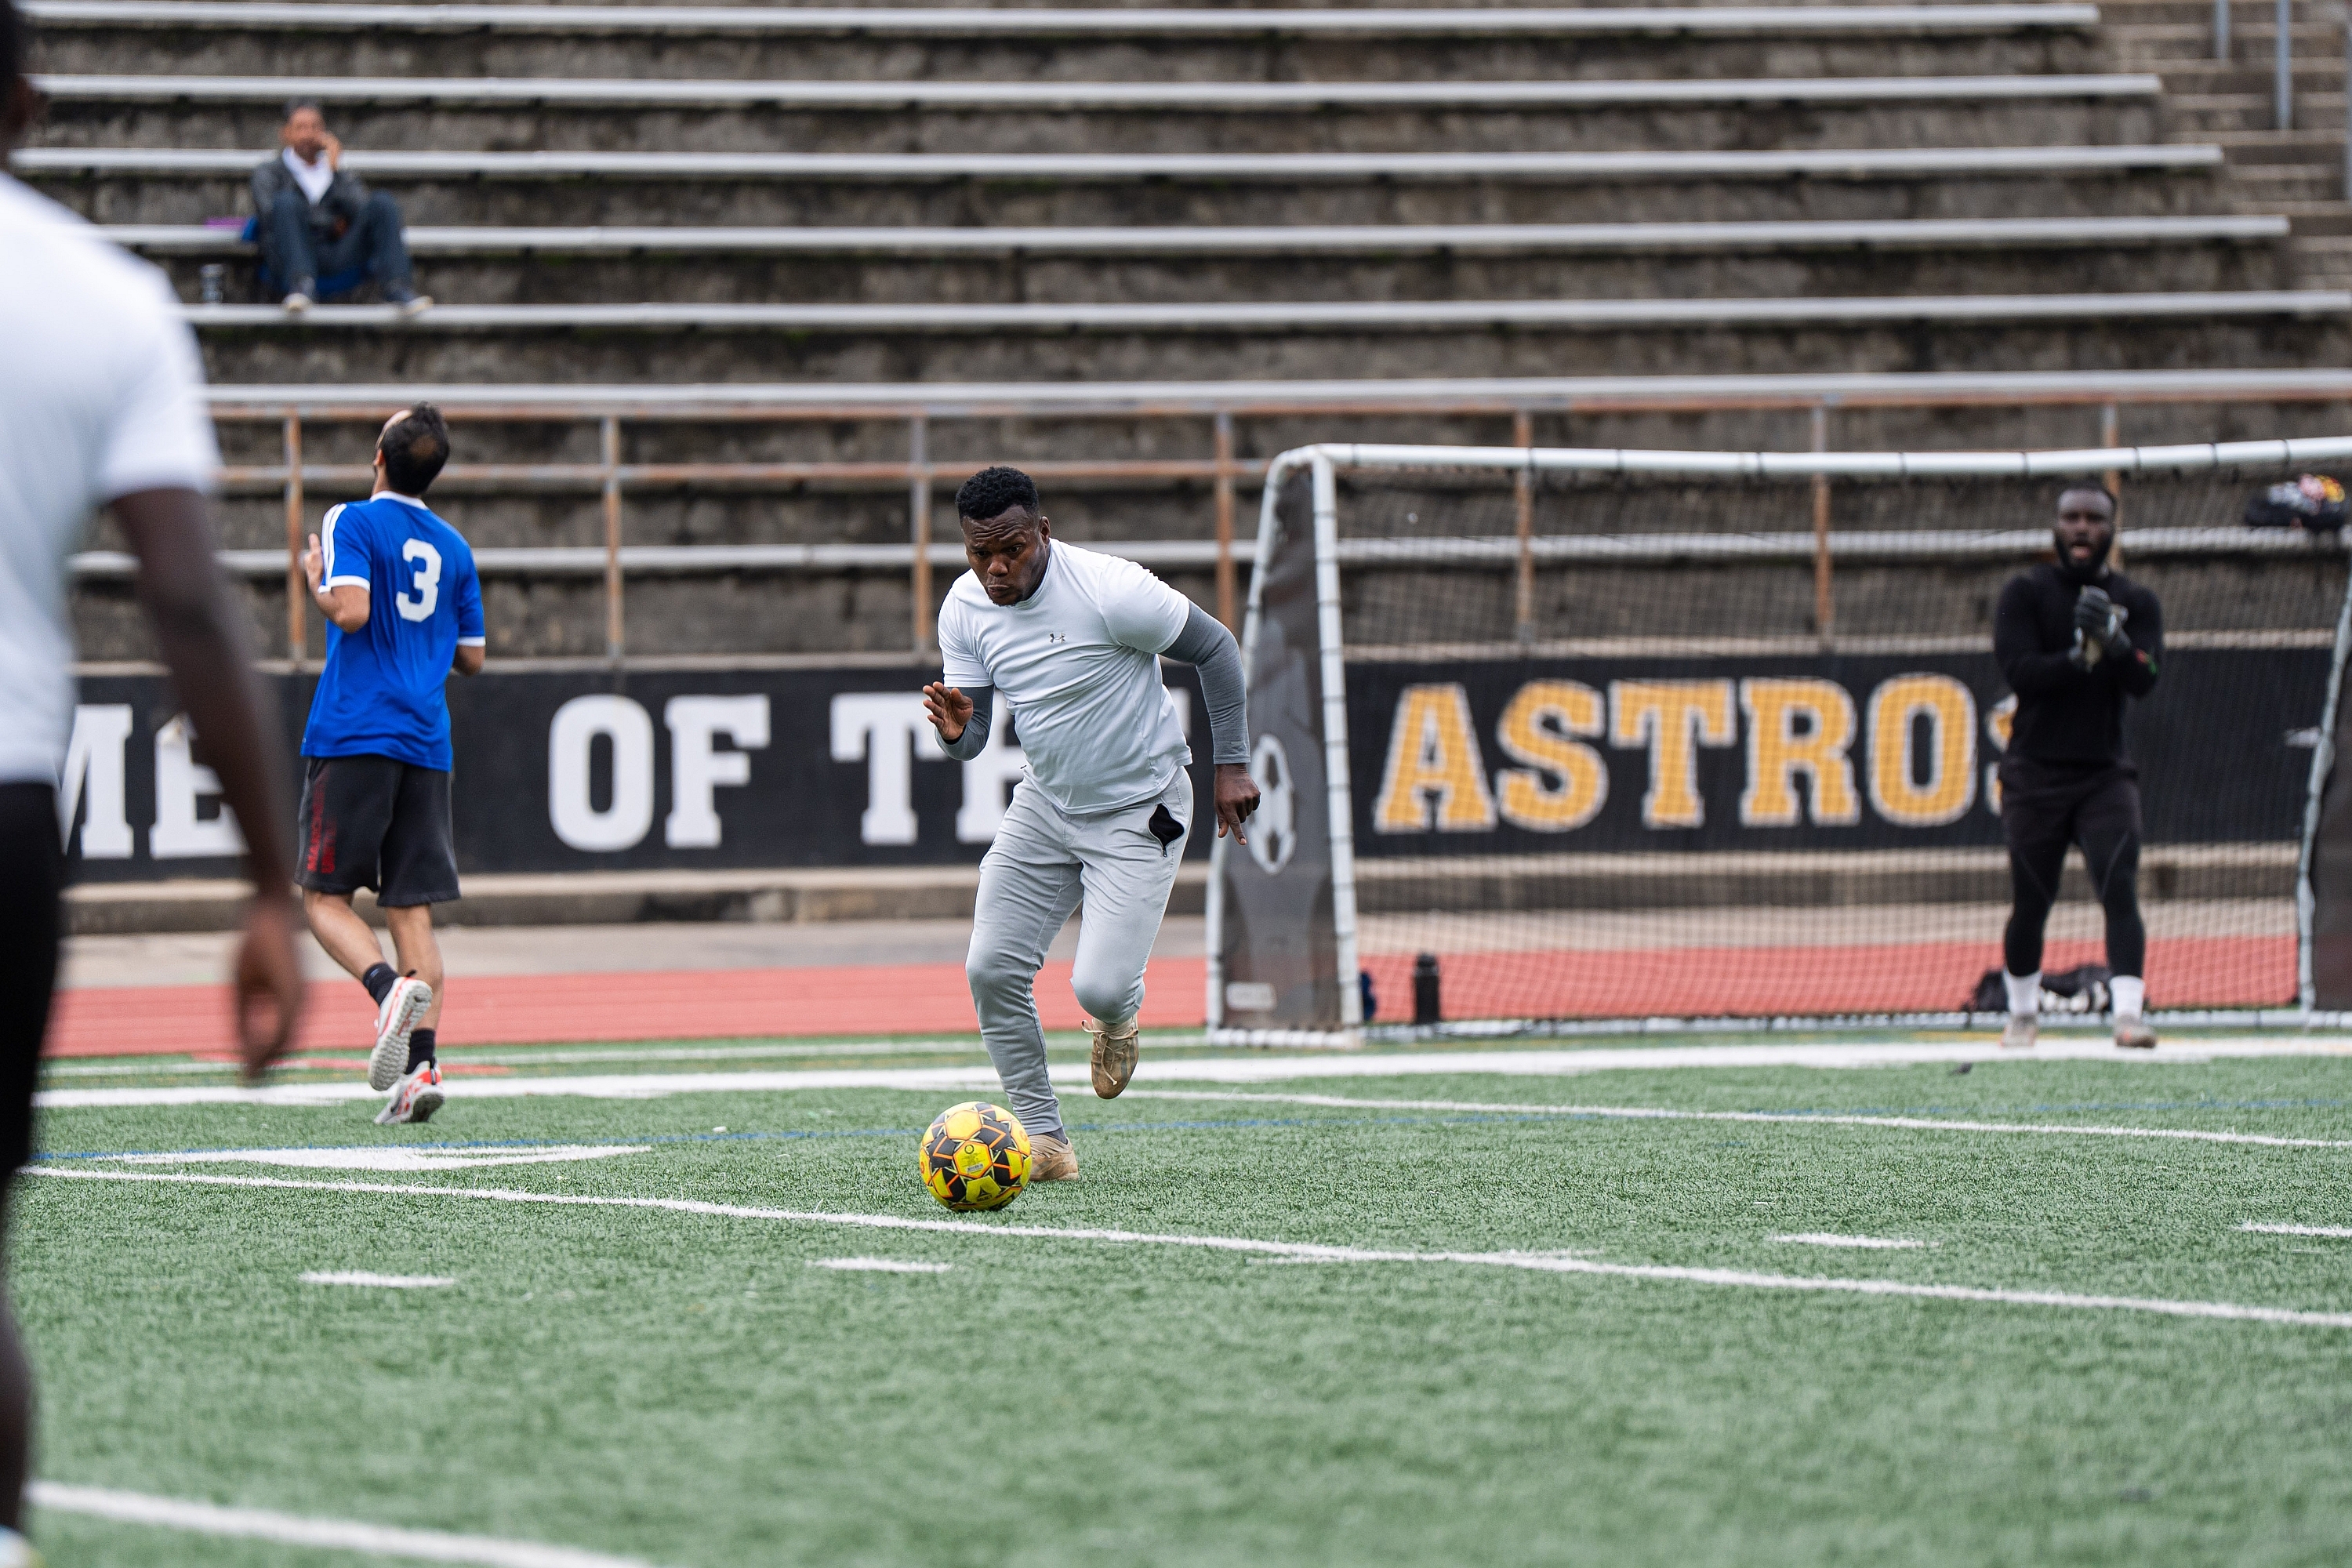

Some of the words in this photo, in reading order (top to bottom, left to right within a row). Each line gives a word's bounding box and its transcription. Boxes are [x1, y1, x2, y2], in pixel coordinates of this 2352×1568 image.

[396, 538, 442, 622] 3
[549, 693, 771, 852] OF
[1374, 671, 2019, 834] ASTRO
